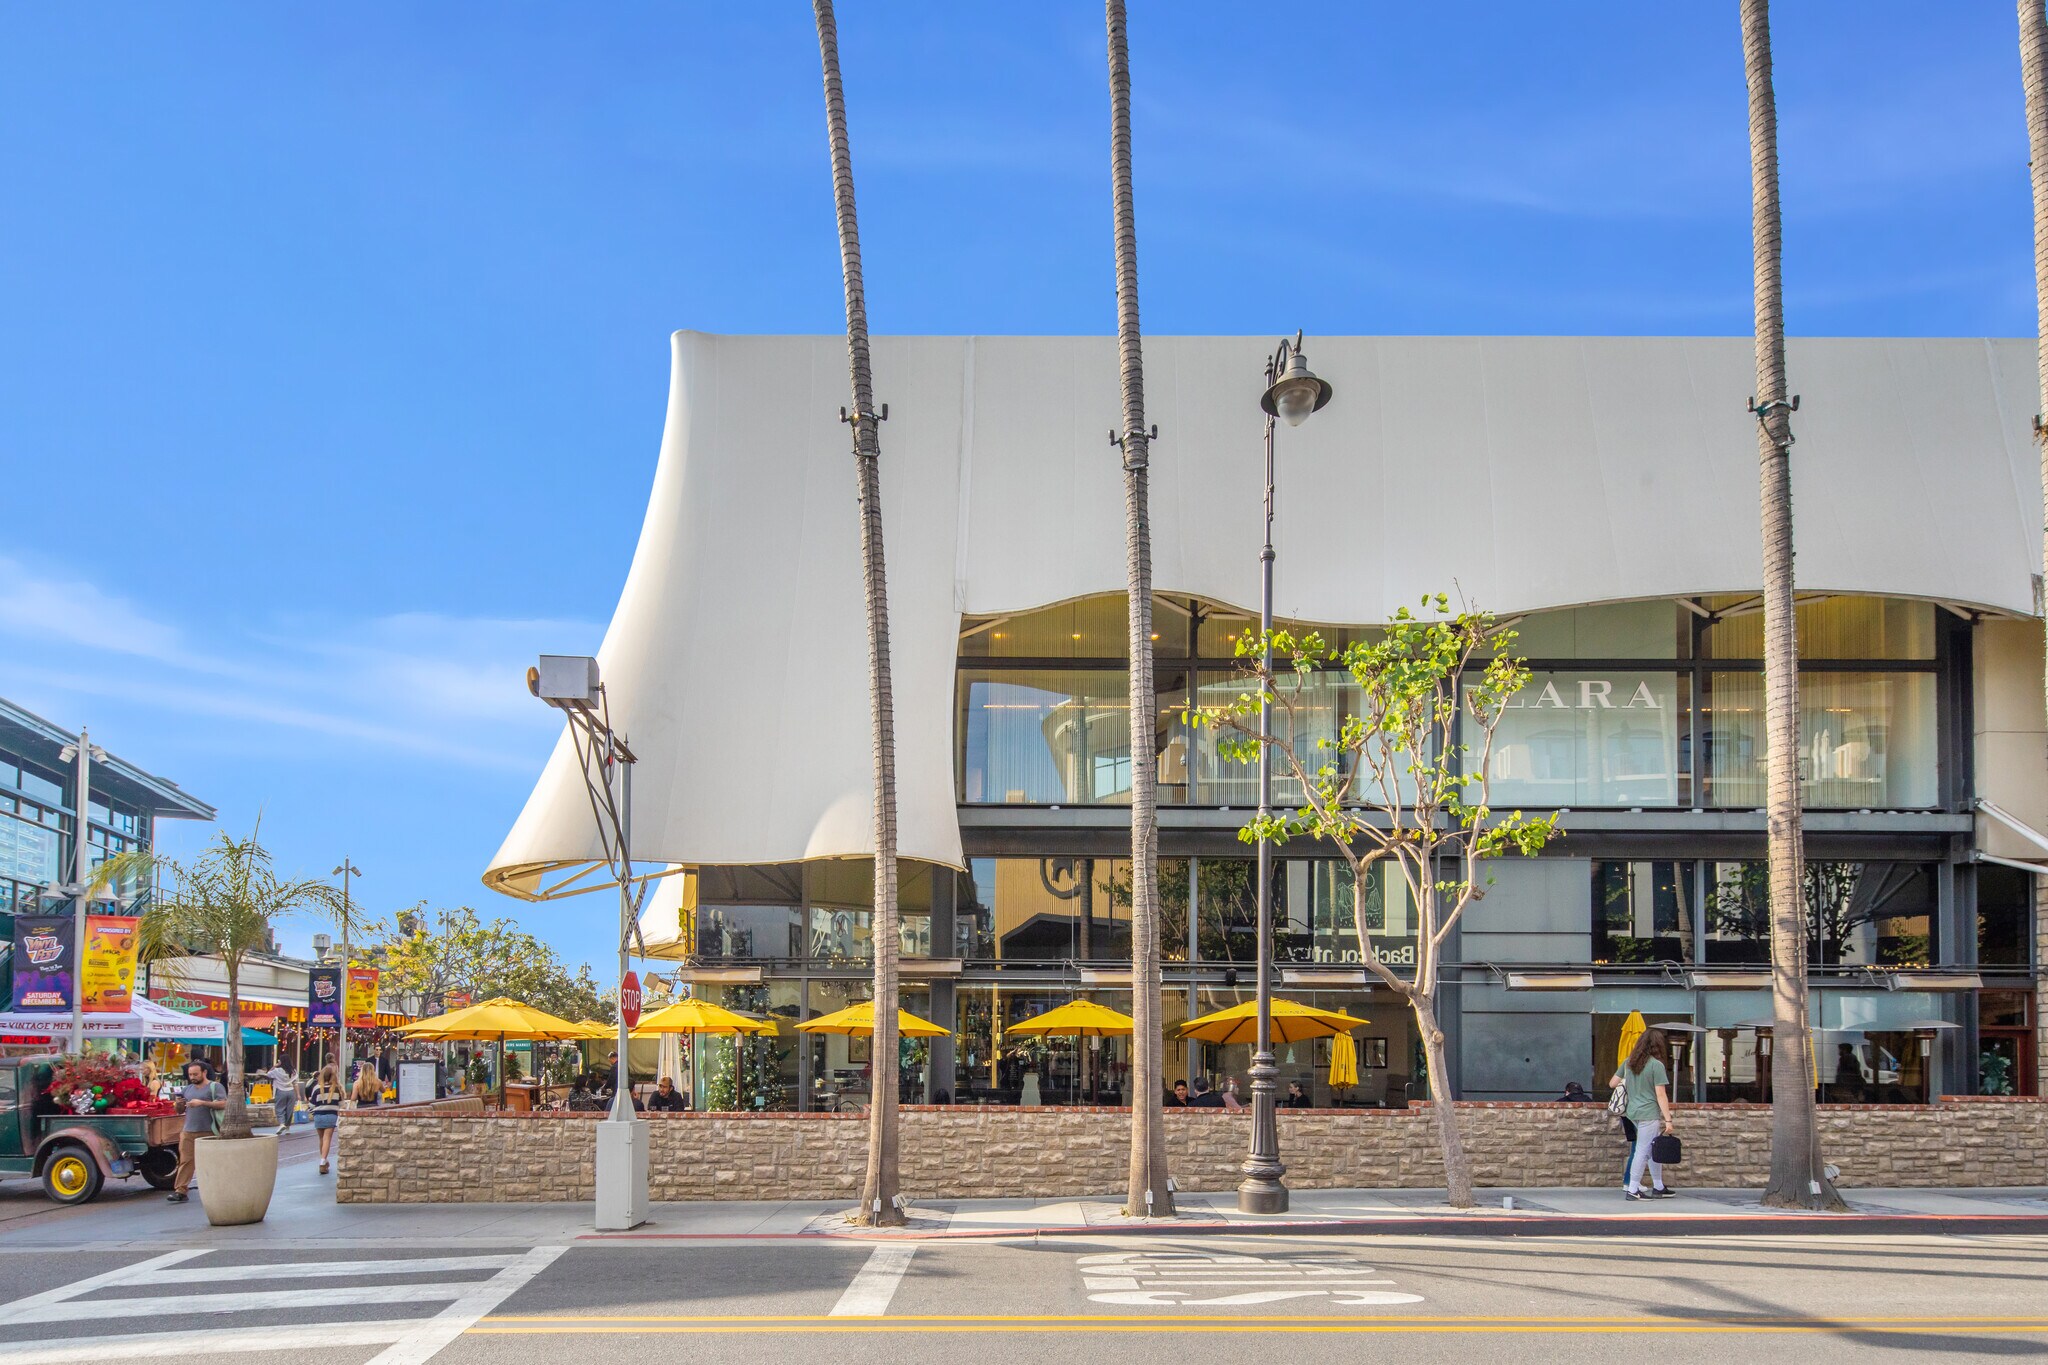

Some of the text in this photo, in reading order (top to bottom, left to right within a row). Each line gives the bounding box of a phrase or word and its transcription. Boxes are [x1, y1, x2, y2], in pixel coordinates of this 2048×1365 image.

[26, 938, 56, 951] VINYL
[22, 998, 56, 1006] DECEMBER
[622, 988, 640, 1011] STOP
[211, 1000, 273, 1011] CATINA
[291, 1007, 305, 1022] EL
[9, 1022, 102, 1030] VINTAGE MEN ART
[163, 1024, 184, 1032] VINTAGE
